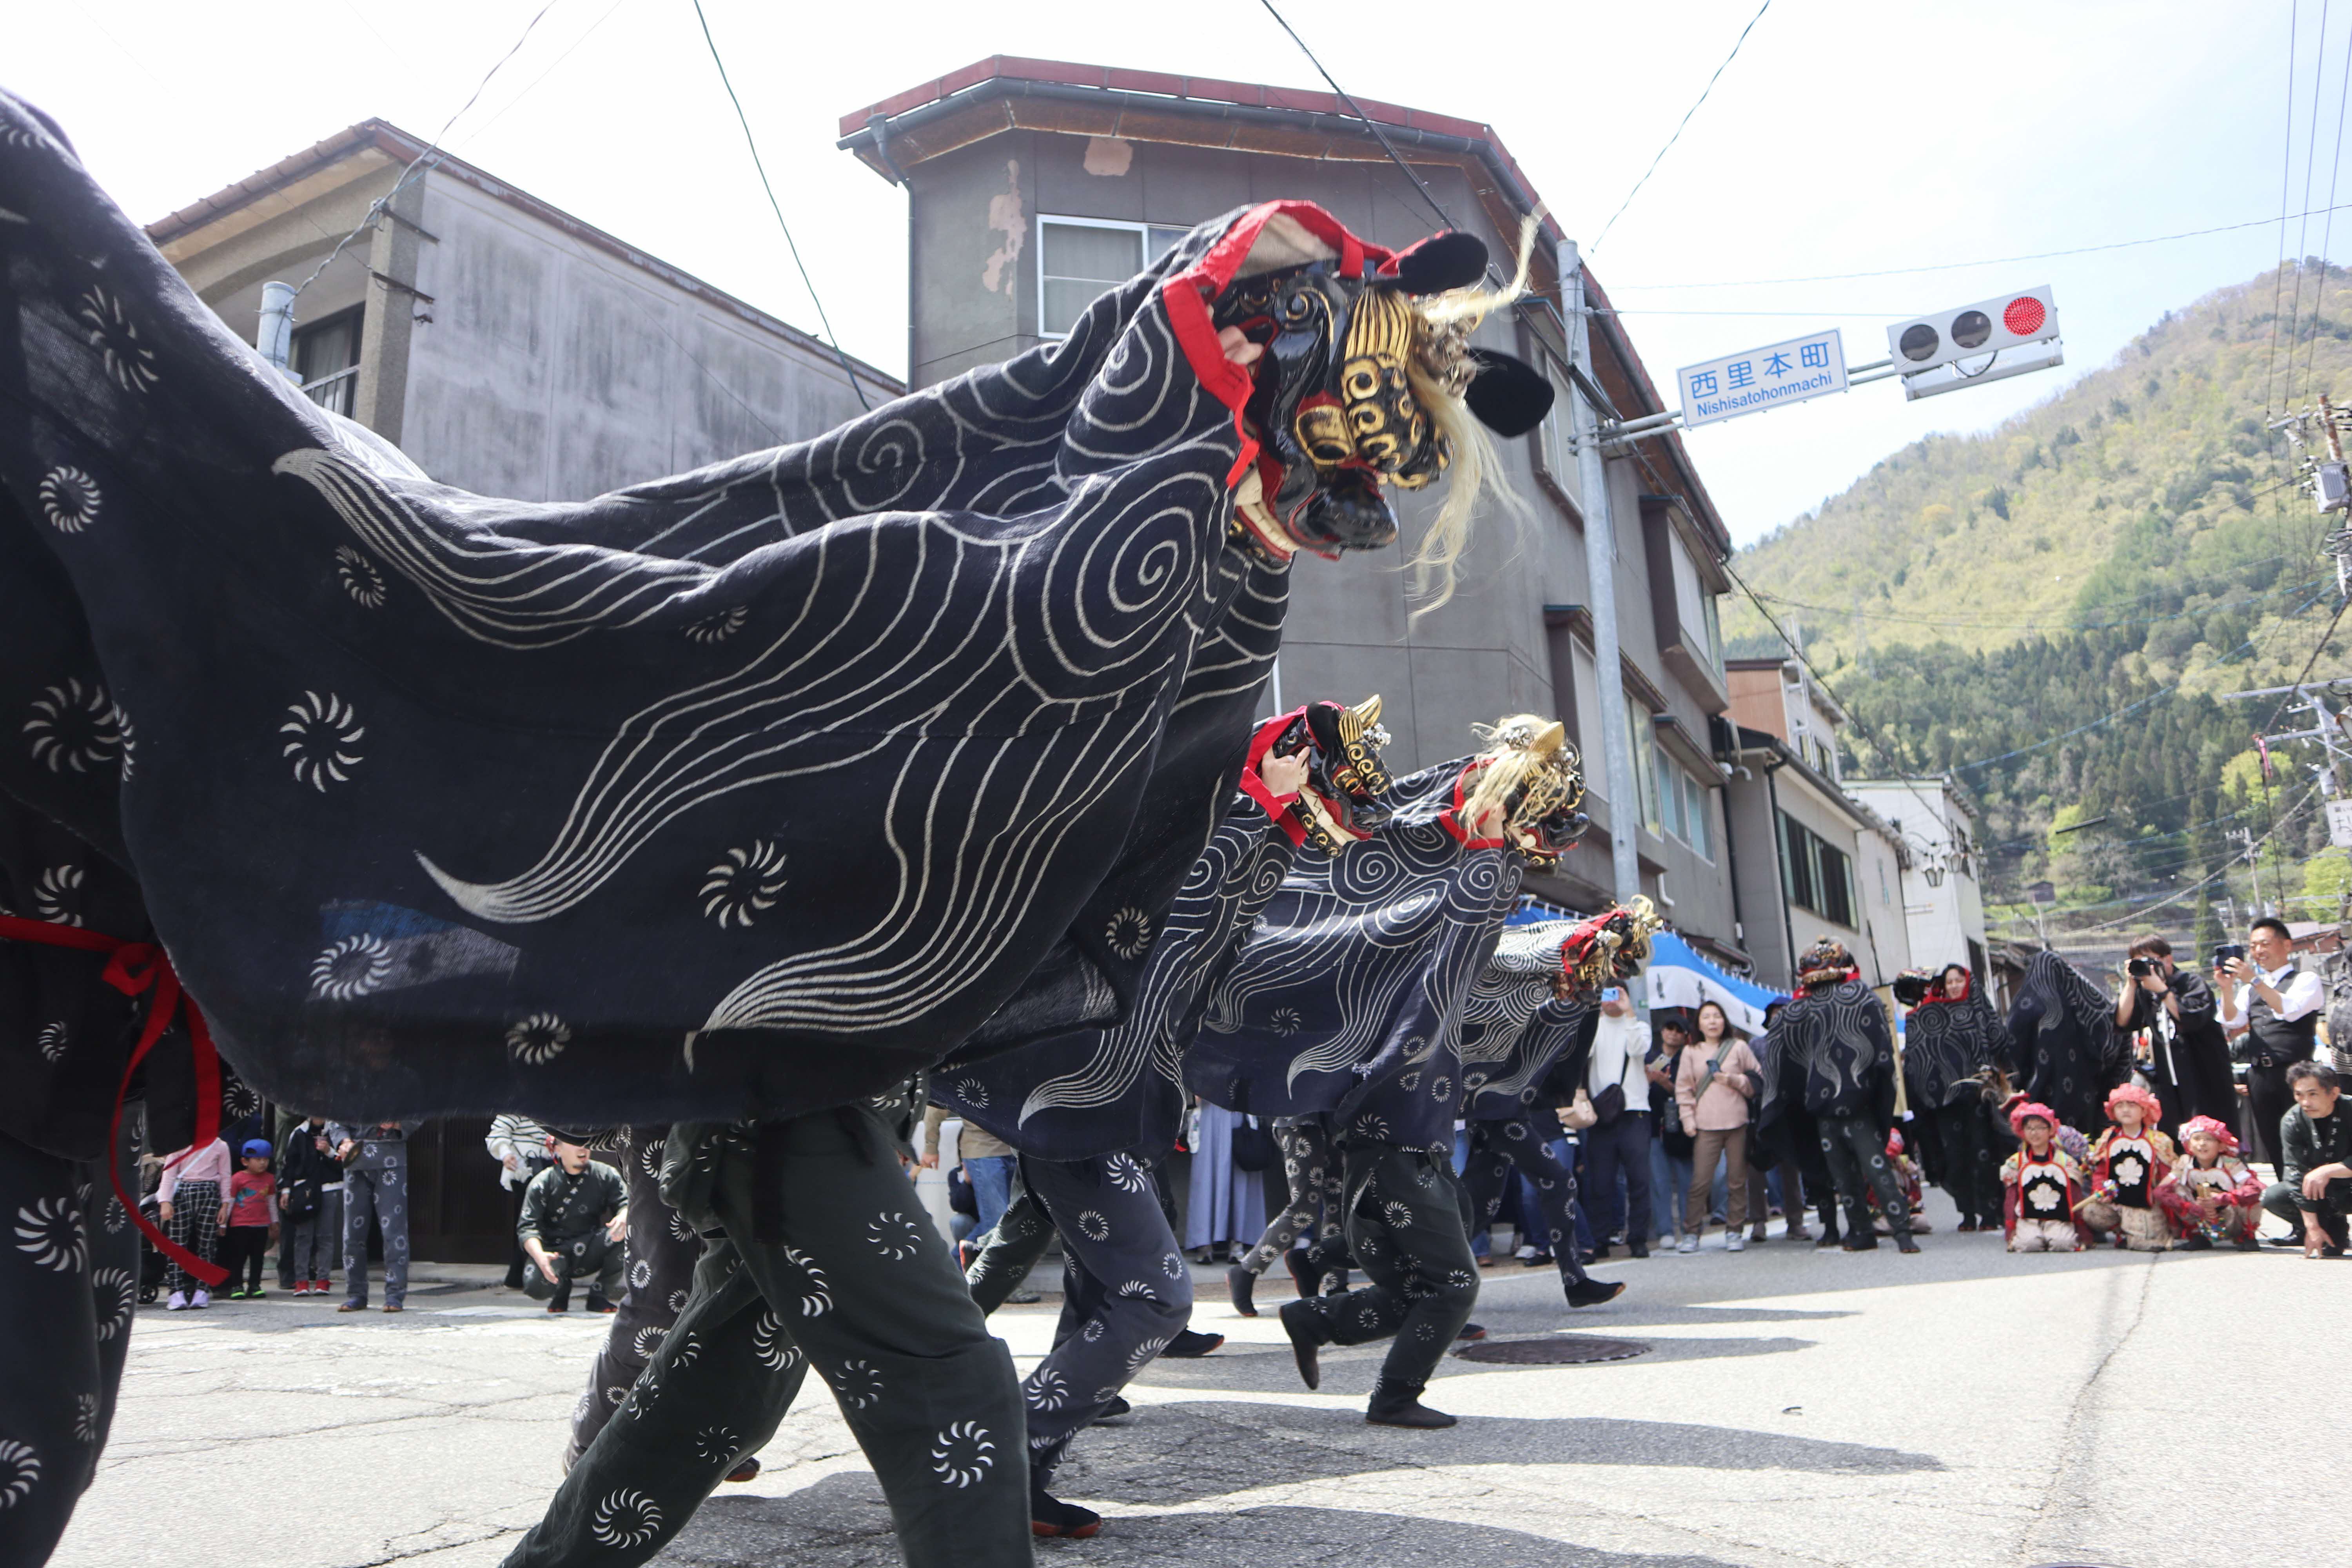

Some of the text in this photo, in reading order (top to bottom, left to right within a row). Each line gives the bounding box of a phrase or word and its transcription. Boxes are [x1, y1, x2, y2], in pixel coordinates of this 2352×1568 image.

[1689, 342, 1829, 399] 西里本町
[1697, 371, 1833, 417] Nishisatohonmachi
